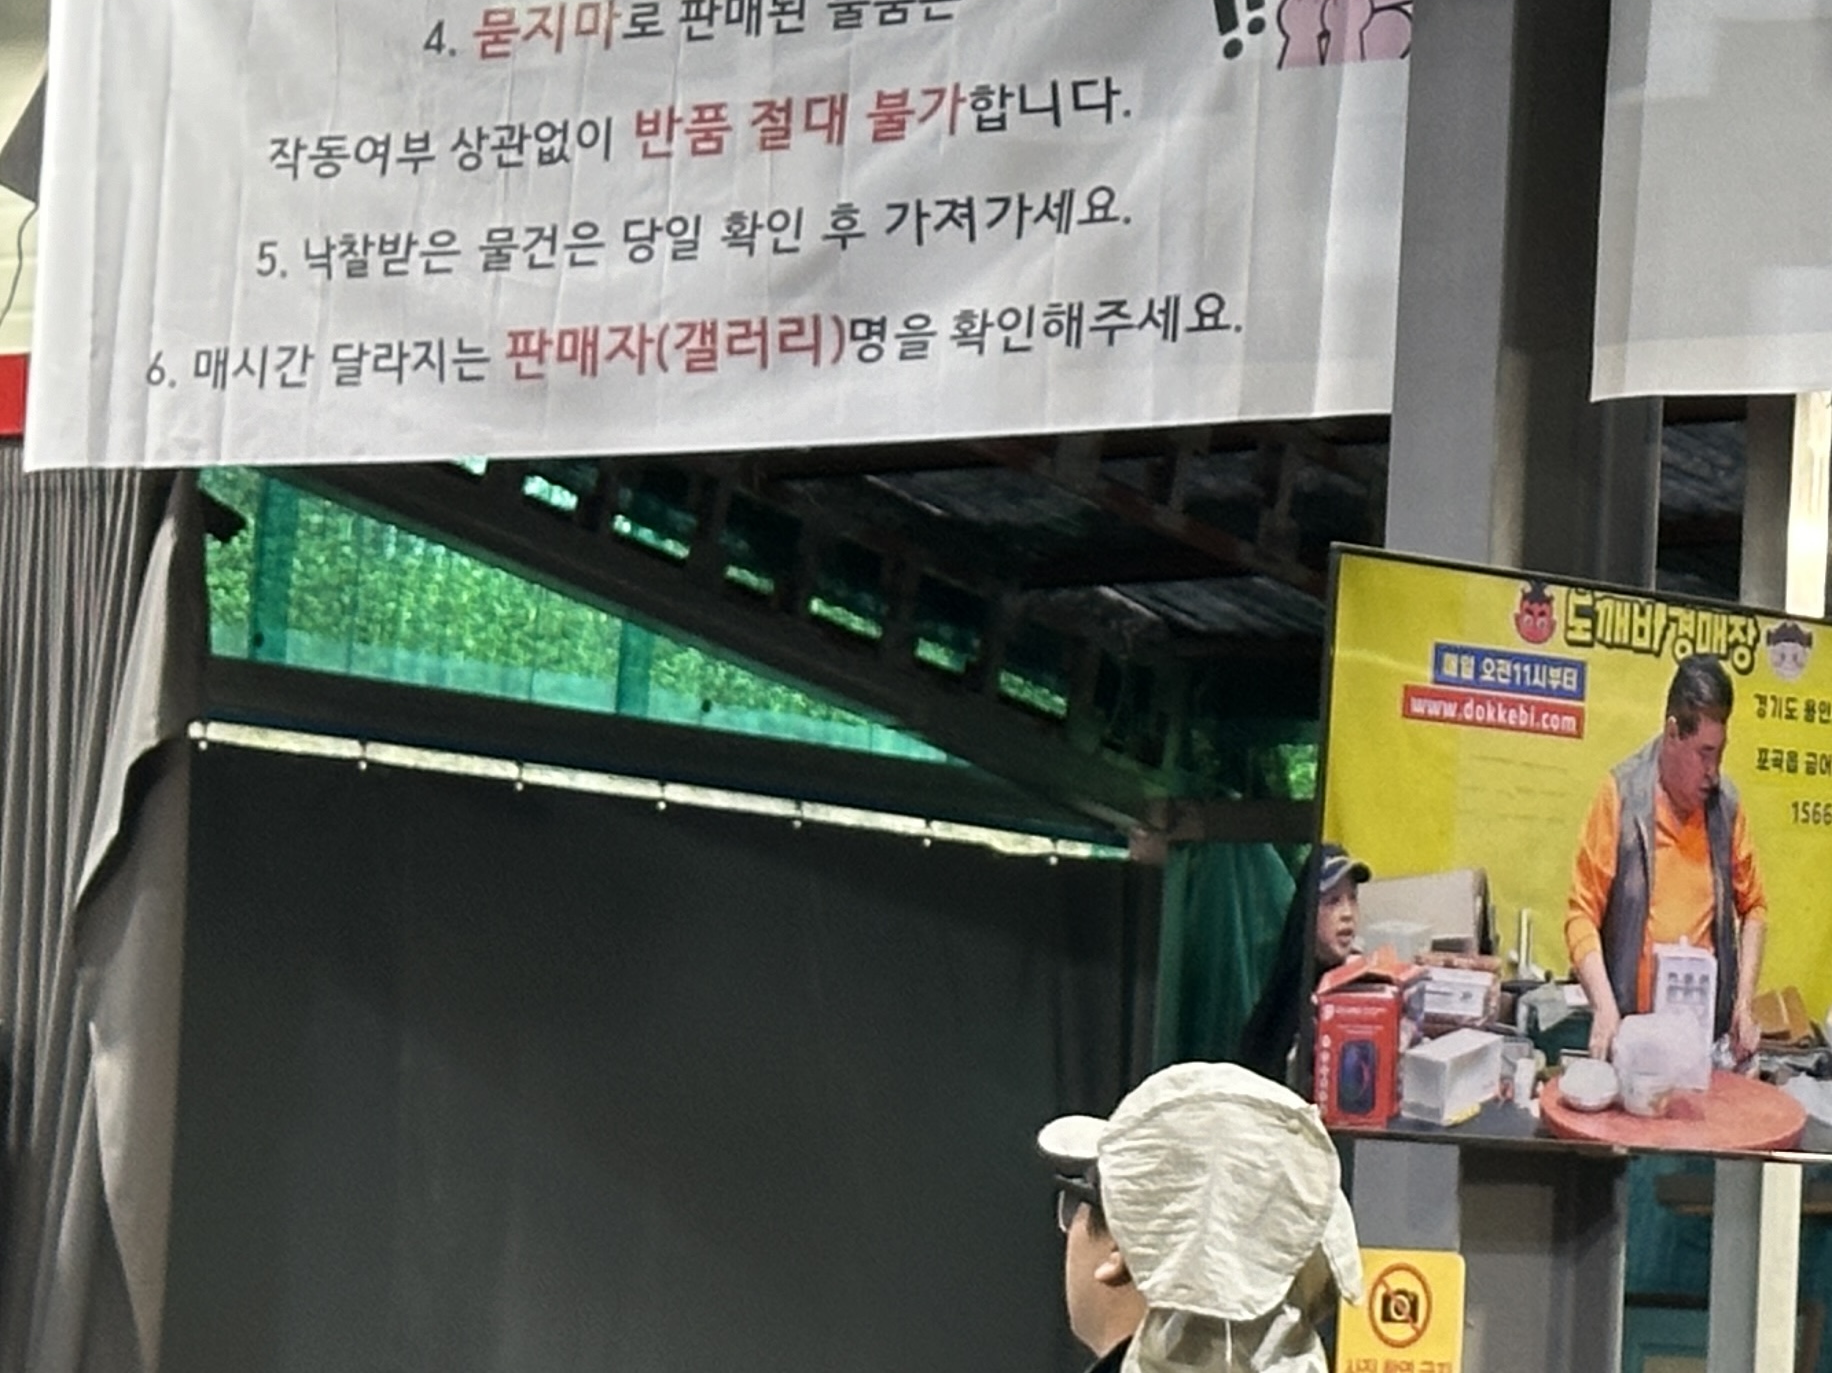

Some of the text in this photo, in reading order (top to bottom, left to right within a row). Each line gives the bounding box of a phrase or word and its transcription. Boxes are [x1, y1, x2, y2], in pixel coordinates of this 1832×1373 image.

[423, 20, 456, 57] 4.
[270, 77, 1131, 181] 작동여부 상관없이 반품 절대 불가합니다.
[257, 186, 1131, 281] 5. 낙찰받은 물건은 당일 확인 후 가져가세요.
[145, 292, 1242, 391] 6. 매시간 달라지는 판매자(갤러리)명을 확인해주세요.
[1410, 694, 1577, 733] www.dokkebi.com
[1755, 694, 1798, 720] 경기도
